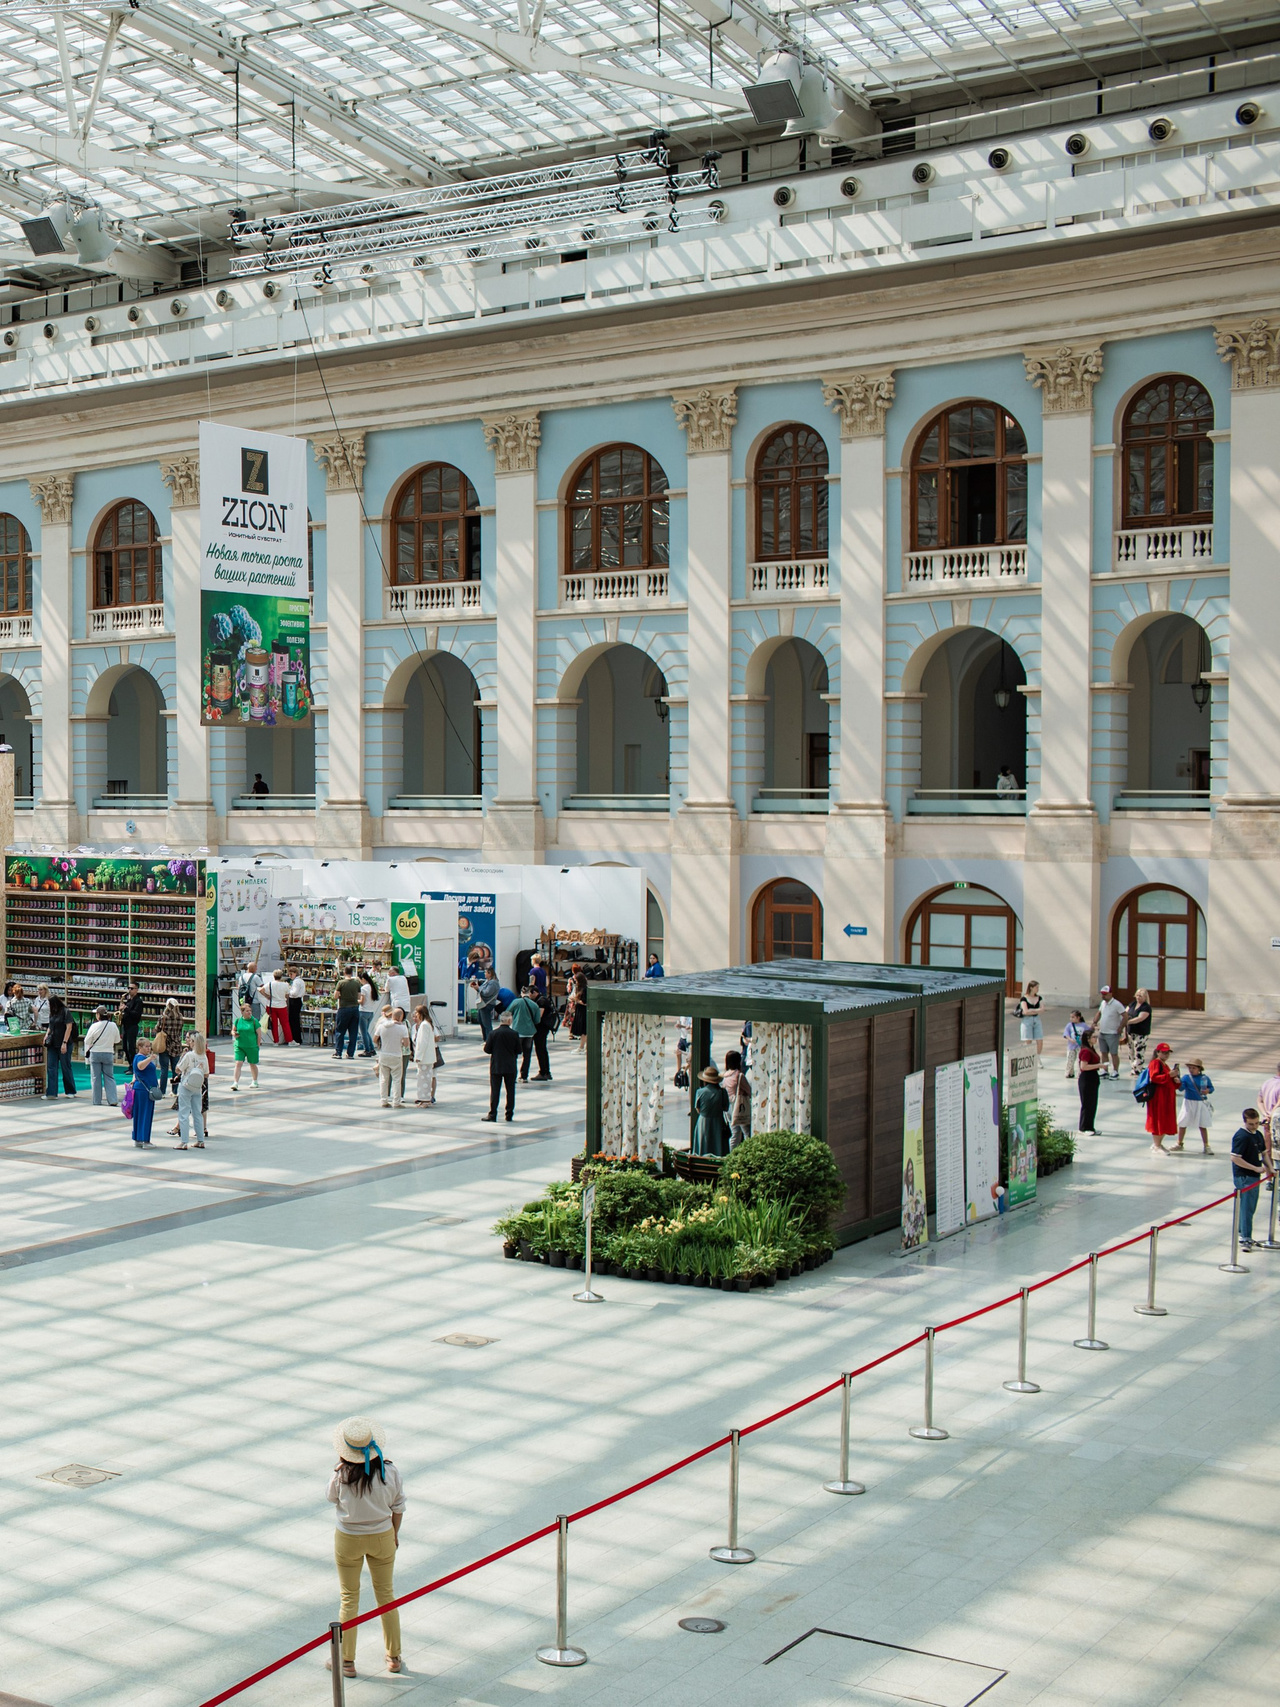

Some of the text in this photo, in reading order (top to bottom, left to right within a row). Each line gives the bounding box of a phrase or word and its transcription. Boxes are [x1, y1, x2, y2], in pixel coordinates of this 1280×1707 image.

[221, 496, 288, 533] ZION
[206, 542, 303, 570] Новая точка роста
[214, 563, 296, 587] ваших растений
[289, 604, 305, 612] ПРОСТО
[280, 619, 305, 628] ЭФФЕКТИВНО
[286, 636, 305, 644] ПОЛЕЗНО
[473, 904, 495, 914] заботу
[348, 913, 361, 926] 18
[398, 918, 417, 928] био
[395, 943, 422, 963] 12 ЛЕТ
[1018, 1055, 1035, 1070] ZION
